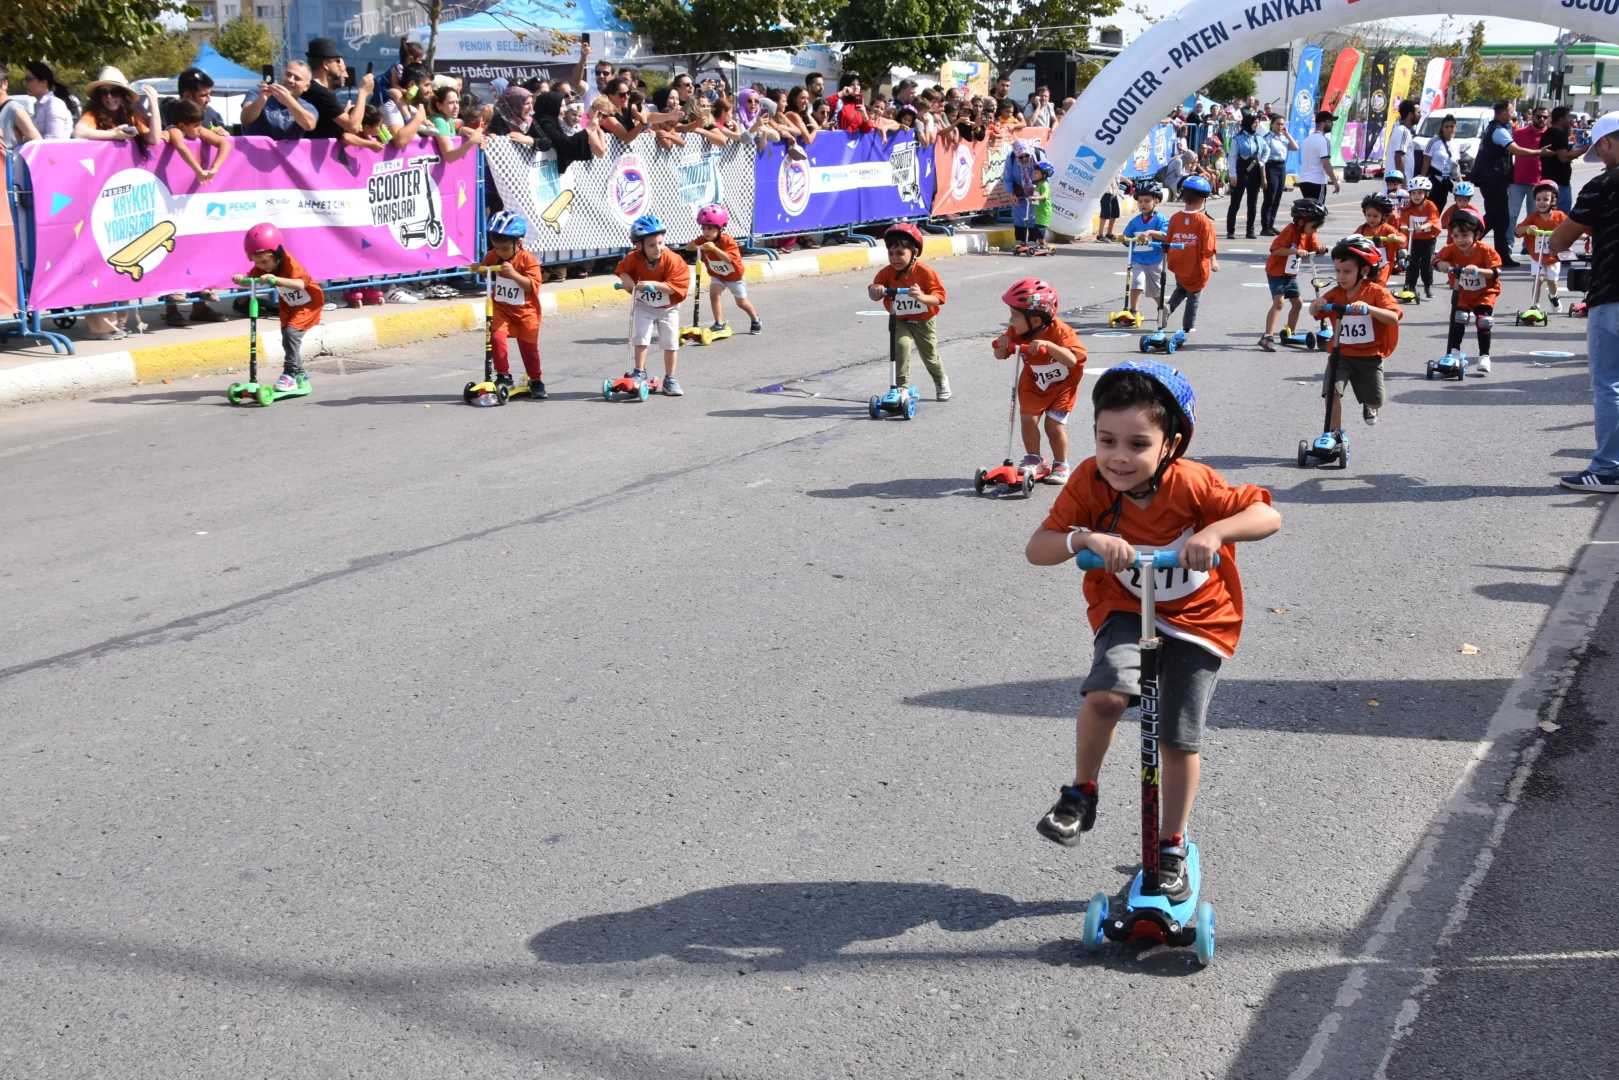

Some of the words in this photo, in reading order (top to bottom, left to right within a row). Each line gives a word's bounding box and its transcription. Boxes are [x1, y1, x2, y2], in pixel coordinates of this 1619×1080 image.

[467, 64, 514, 78] DAĞITIM
[1095, 70, 1162, 145] SCOOTER
[1168, 20, 1229, 69] PATEN
[368, 169, 420, 204] SCOOTER
[678, 161, 711, 188] SCOOTER
[113, 182, 156, 217] KAYKAY
[371, 198, 416, 225] YARIŞLARI
[496, 285, 519, 299] 2167
[896, 300, 921, 311] 2174
[1339, 323, 1366, 337] 2163
[1141, 784, 1159, 875] Scooter
